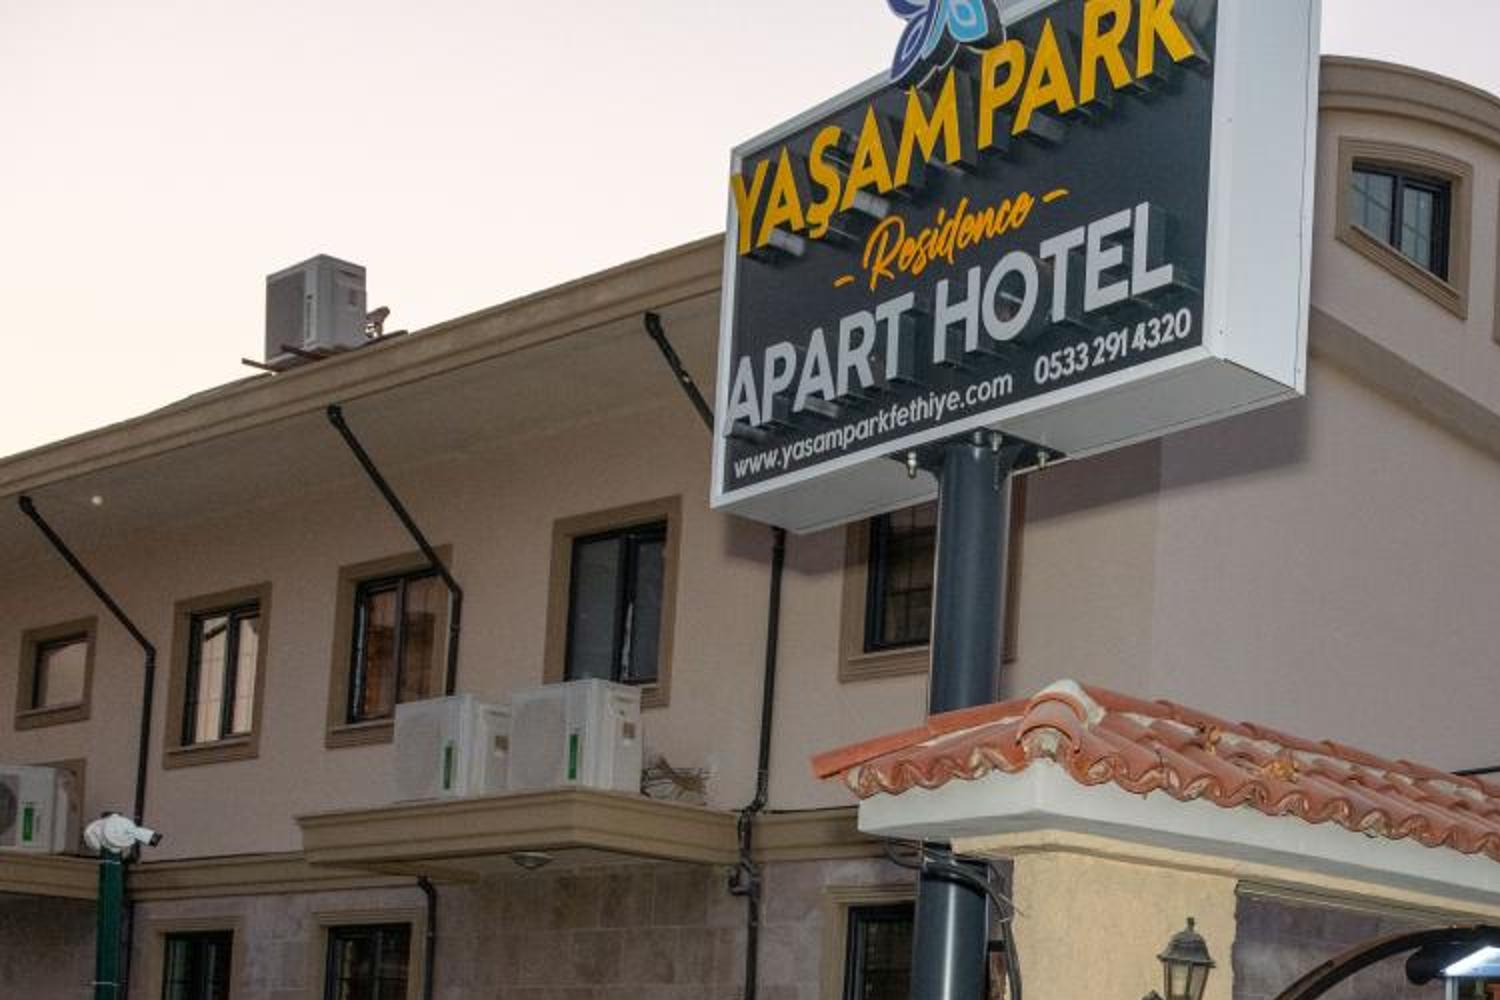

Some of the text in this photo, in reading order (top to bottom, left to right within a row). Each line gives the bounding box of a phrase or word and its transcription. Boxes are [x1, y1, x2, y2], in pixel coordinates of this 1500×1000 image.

[731, 0, 1195, 256] YAŞAM PARK
[723, 201, 1173, 436] APART HOTEL
[864, 191, 1034, 293] Residence
[733, 372, 1013, 479] www.yasamparkfethiye.com
